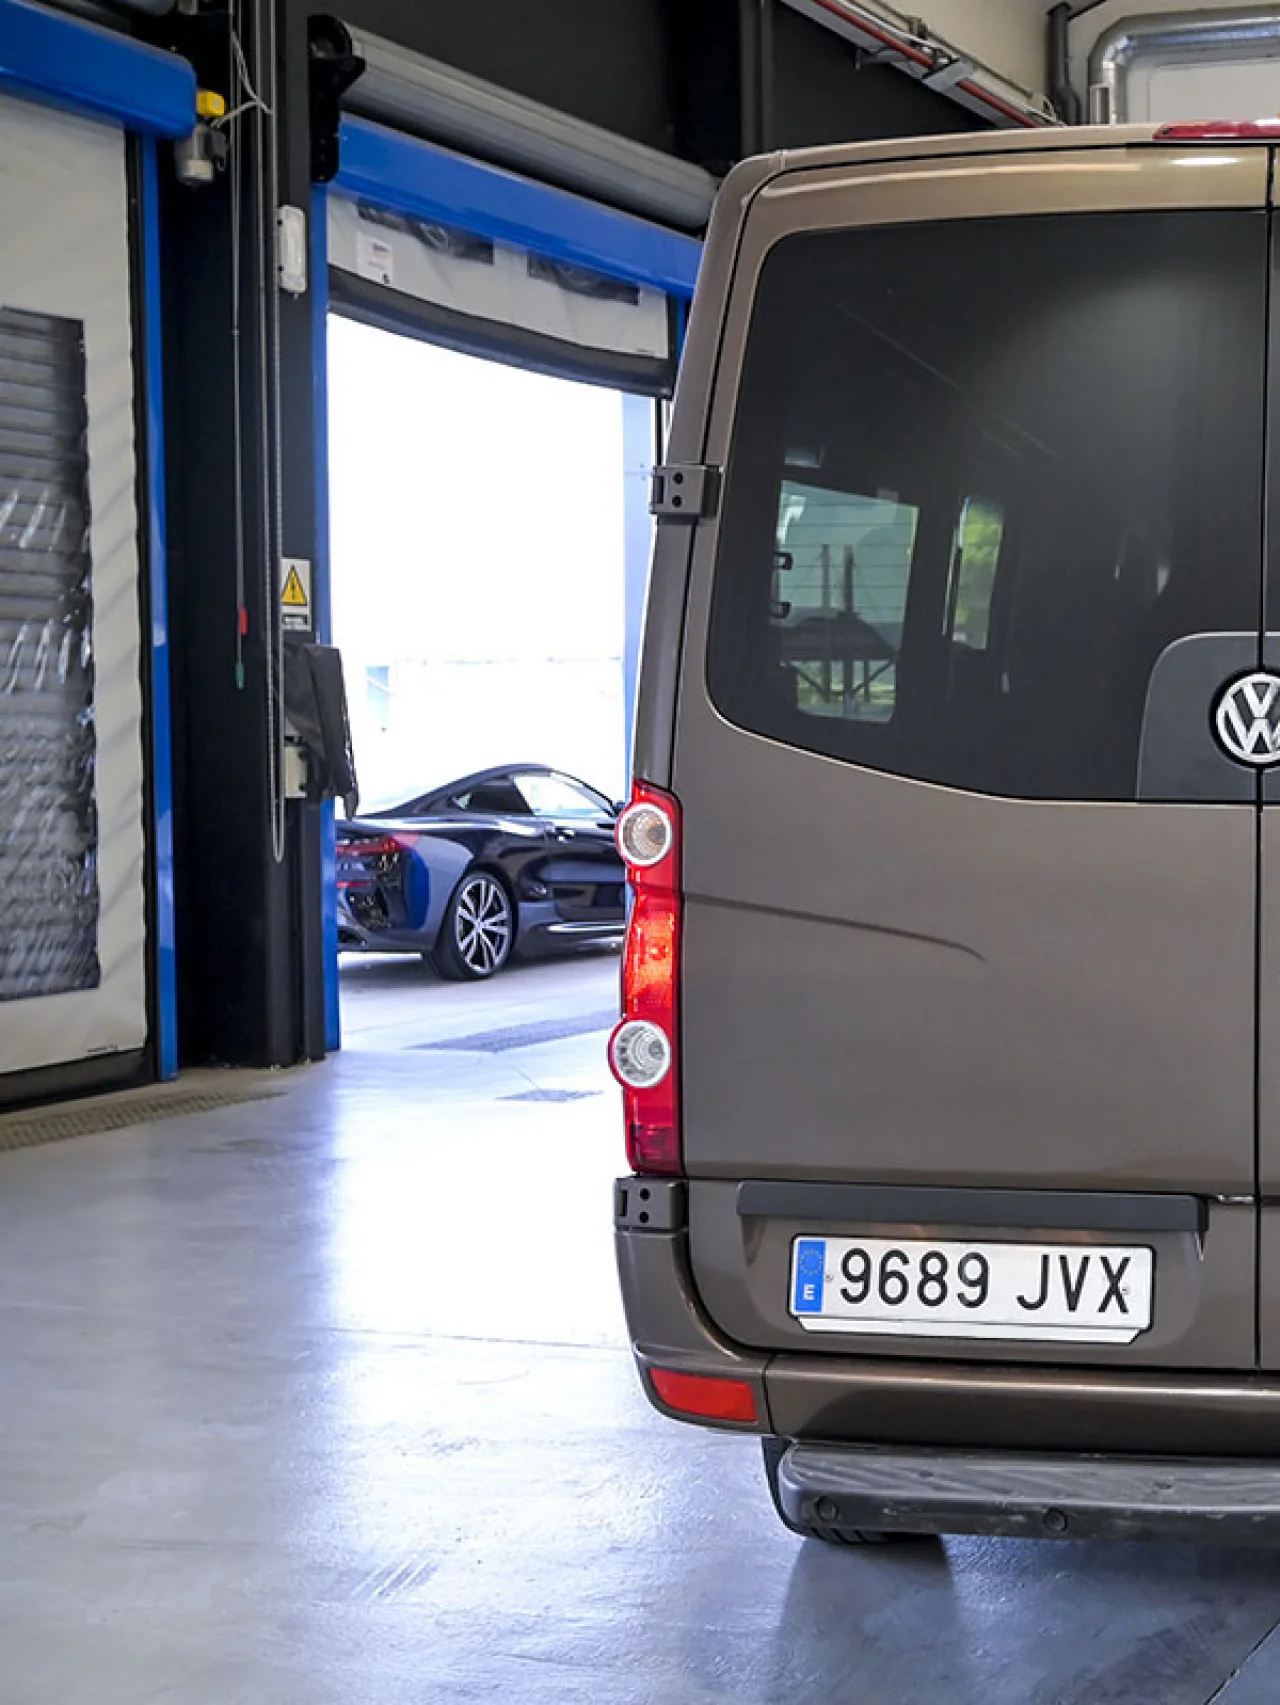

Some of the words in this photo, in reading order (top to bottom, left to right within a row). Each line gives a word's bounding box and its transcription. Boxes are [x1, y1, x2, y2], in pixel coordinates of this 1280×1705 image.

[803, 1284, 815, 1301] E
[840, 1248, 990, 1309] 9689
[1016, 1254, 1132, 1314] JVX
